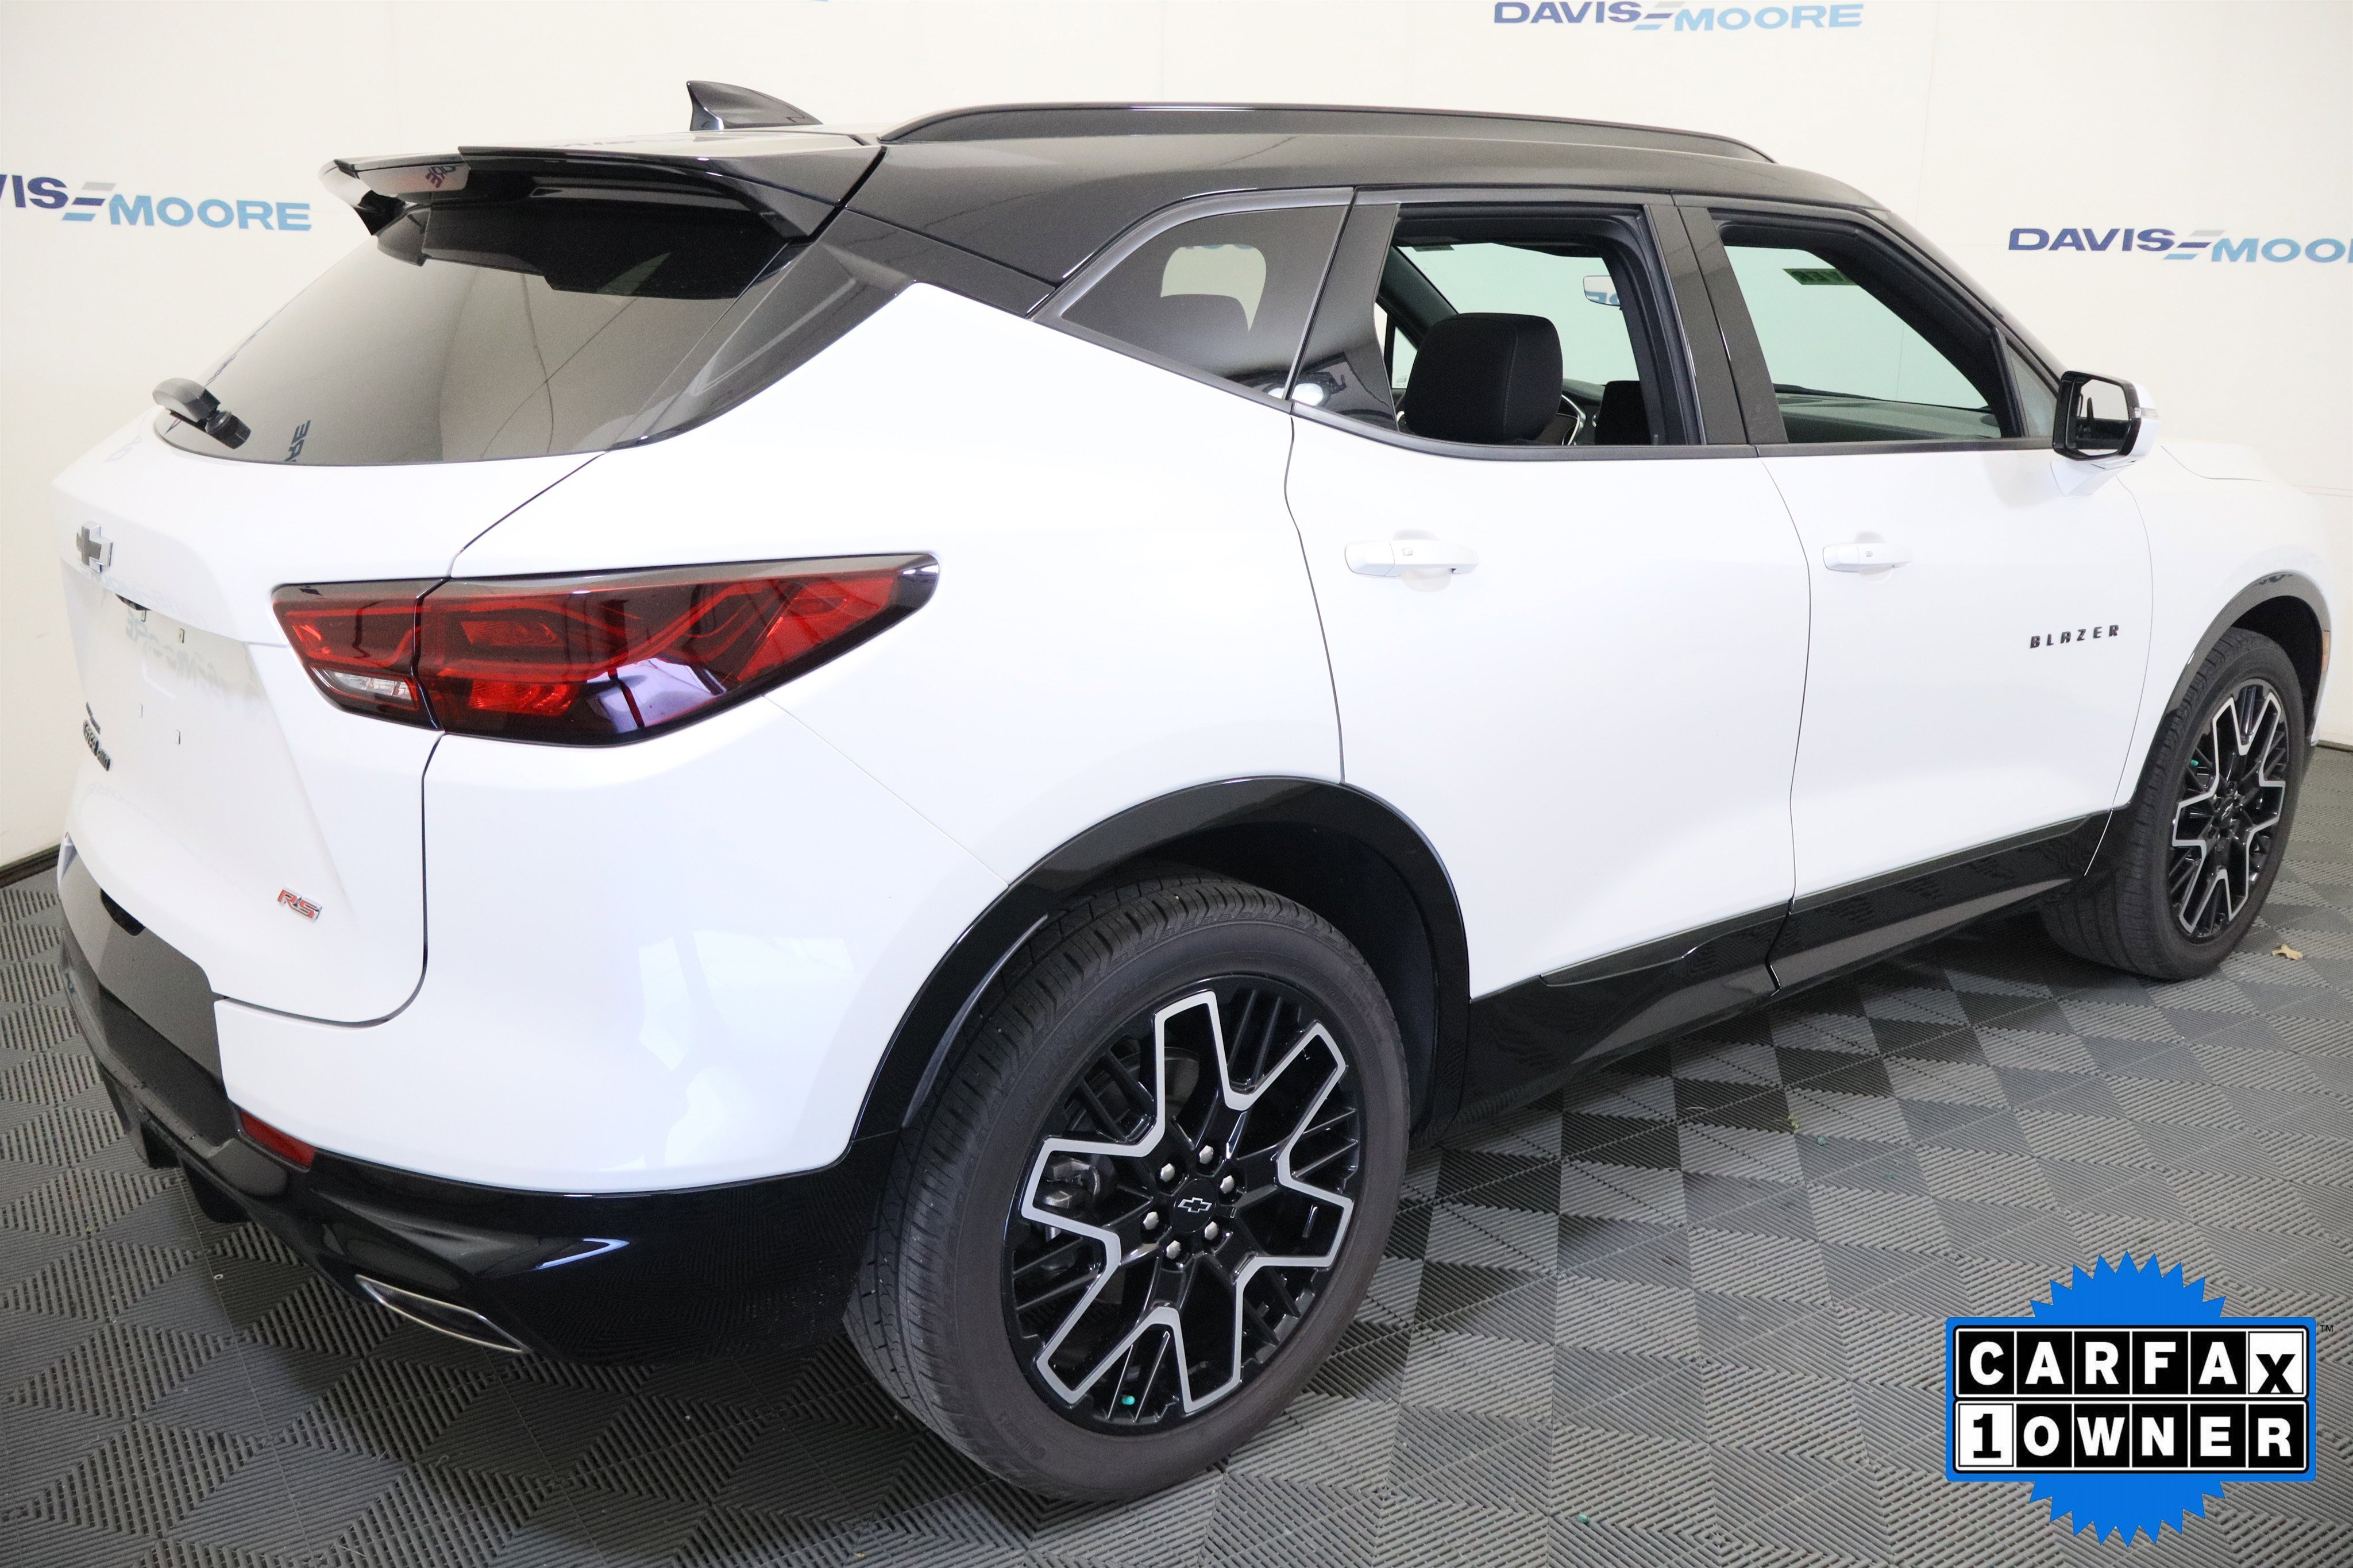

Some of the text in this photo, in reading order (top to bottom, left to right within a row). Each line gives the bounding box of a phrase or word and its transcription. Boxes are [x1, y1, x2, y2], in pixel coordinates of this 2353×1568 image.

[1494, 1, 1864, 32] DAVIS MOORE
[0, 174, 312, 231] IS MOORE
[2008, 227, 2353, 264] DAVIS MOO
[2030, 624, 2119, 649] BLAZER
[277, 889, 322, 921] RS
